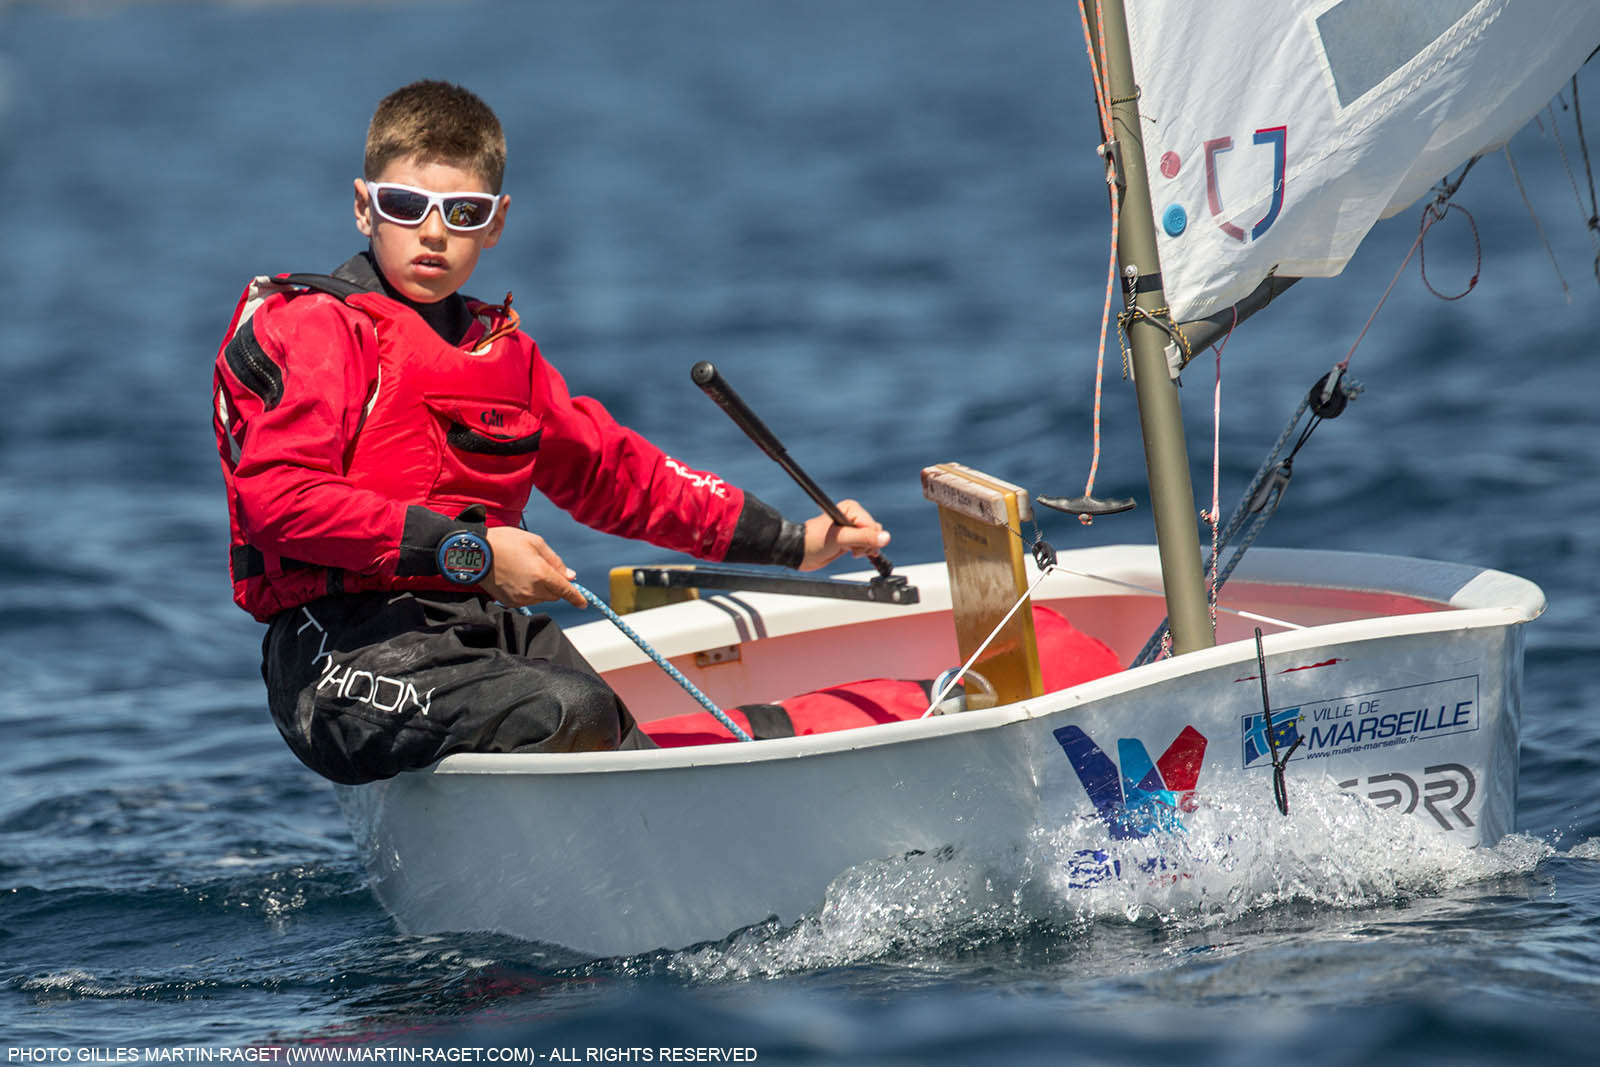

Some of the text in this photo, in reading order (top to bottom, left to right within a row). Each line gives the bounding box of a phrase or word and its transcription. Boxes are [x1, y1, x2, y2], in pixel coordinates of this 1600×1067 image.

[480, 408, 504, 427] Gill
[1313, 699, 1381, 722] VILLE DE
[1308, 700, 1473, 751] MARSEILLE
[1306, 734, 1419, 760] www.mairie-marseille.fr
